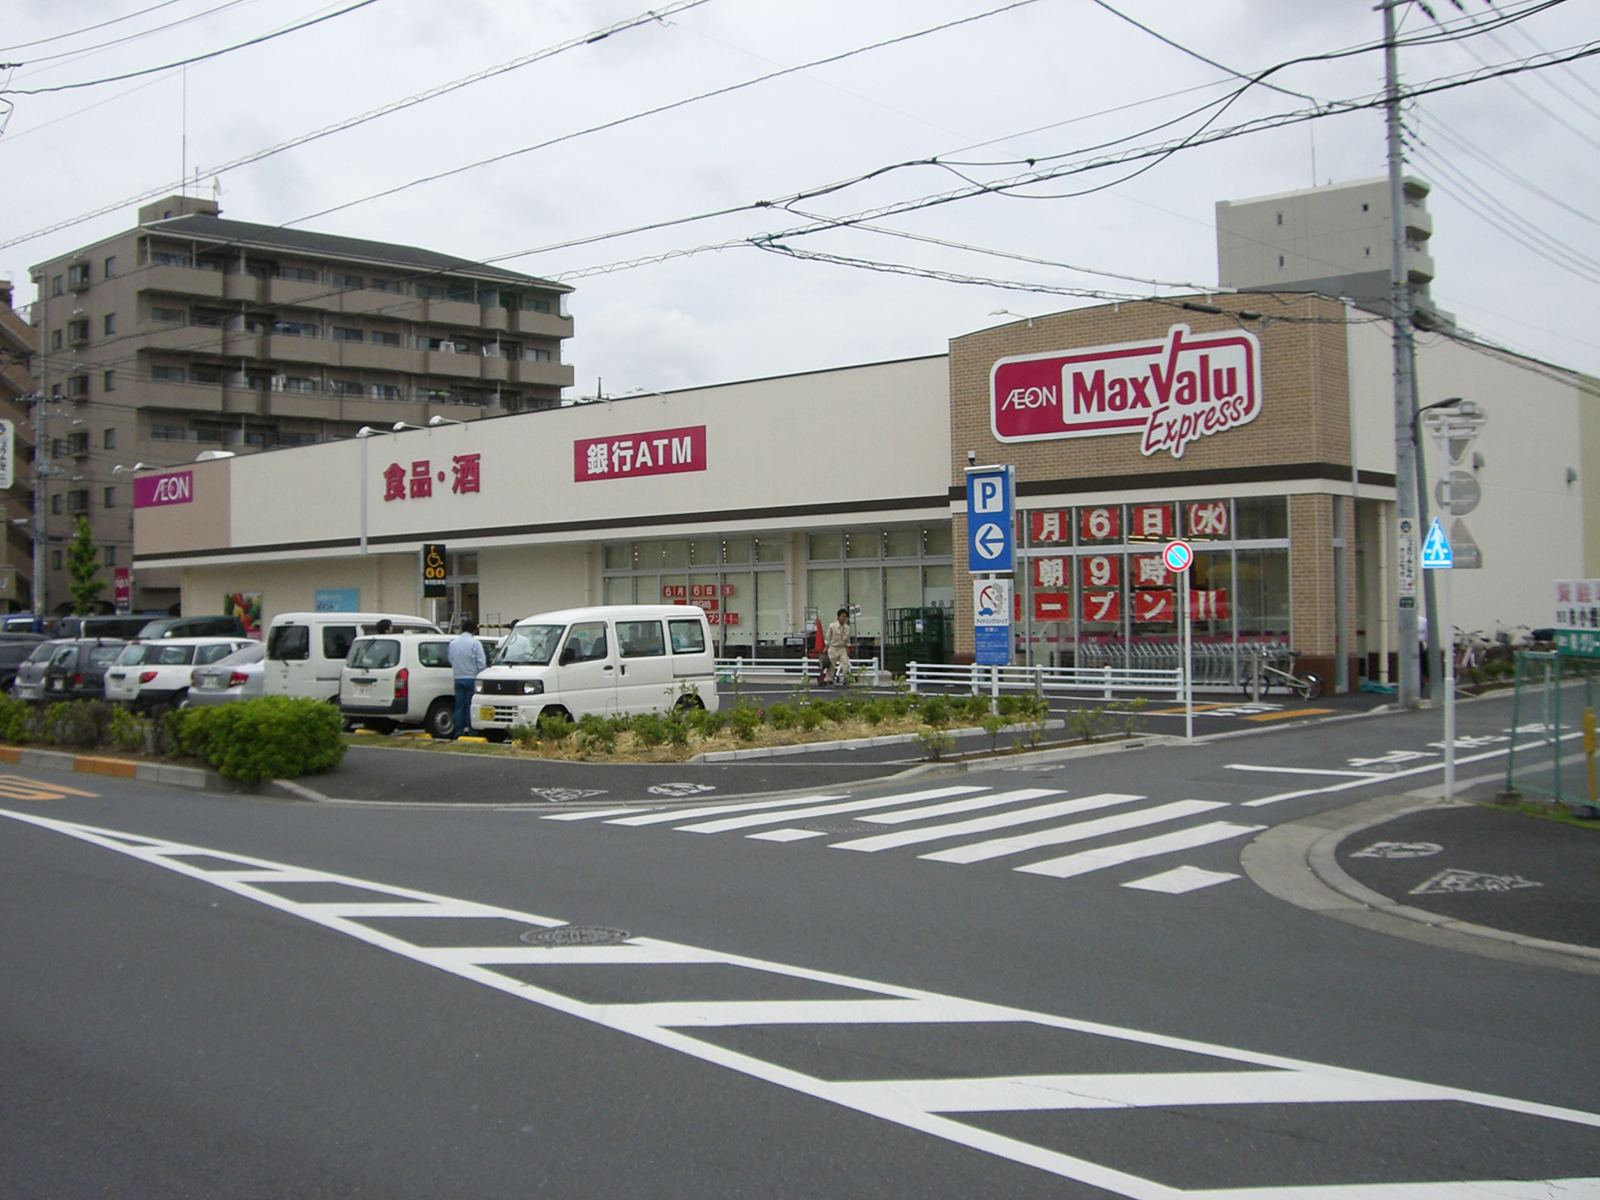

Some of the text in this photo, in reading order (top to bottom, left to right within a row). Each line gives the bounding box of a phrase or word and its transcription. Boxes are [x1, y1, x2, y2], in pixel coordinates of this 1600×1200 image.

[1072, 330, 1237, 415] MaxValu
[1144, 394, 1244, 454] Express
[587, 436, 692, 475] 銀行ATM
[981, 482, 997, 510] P
